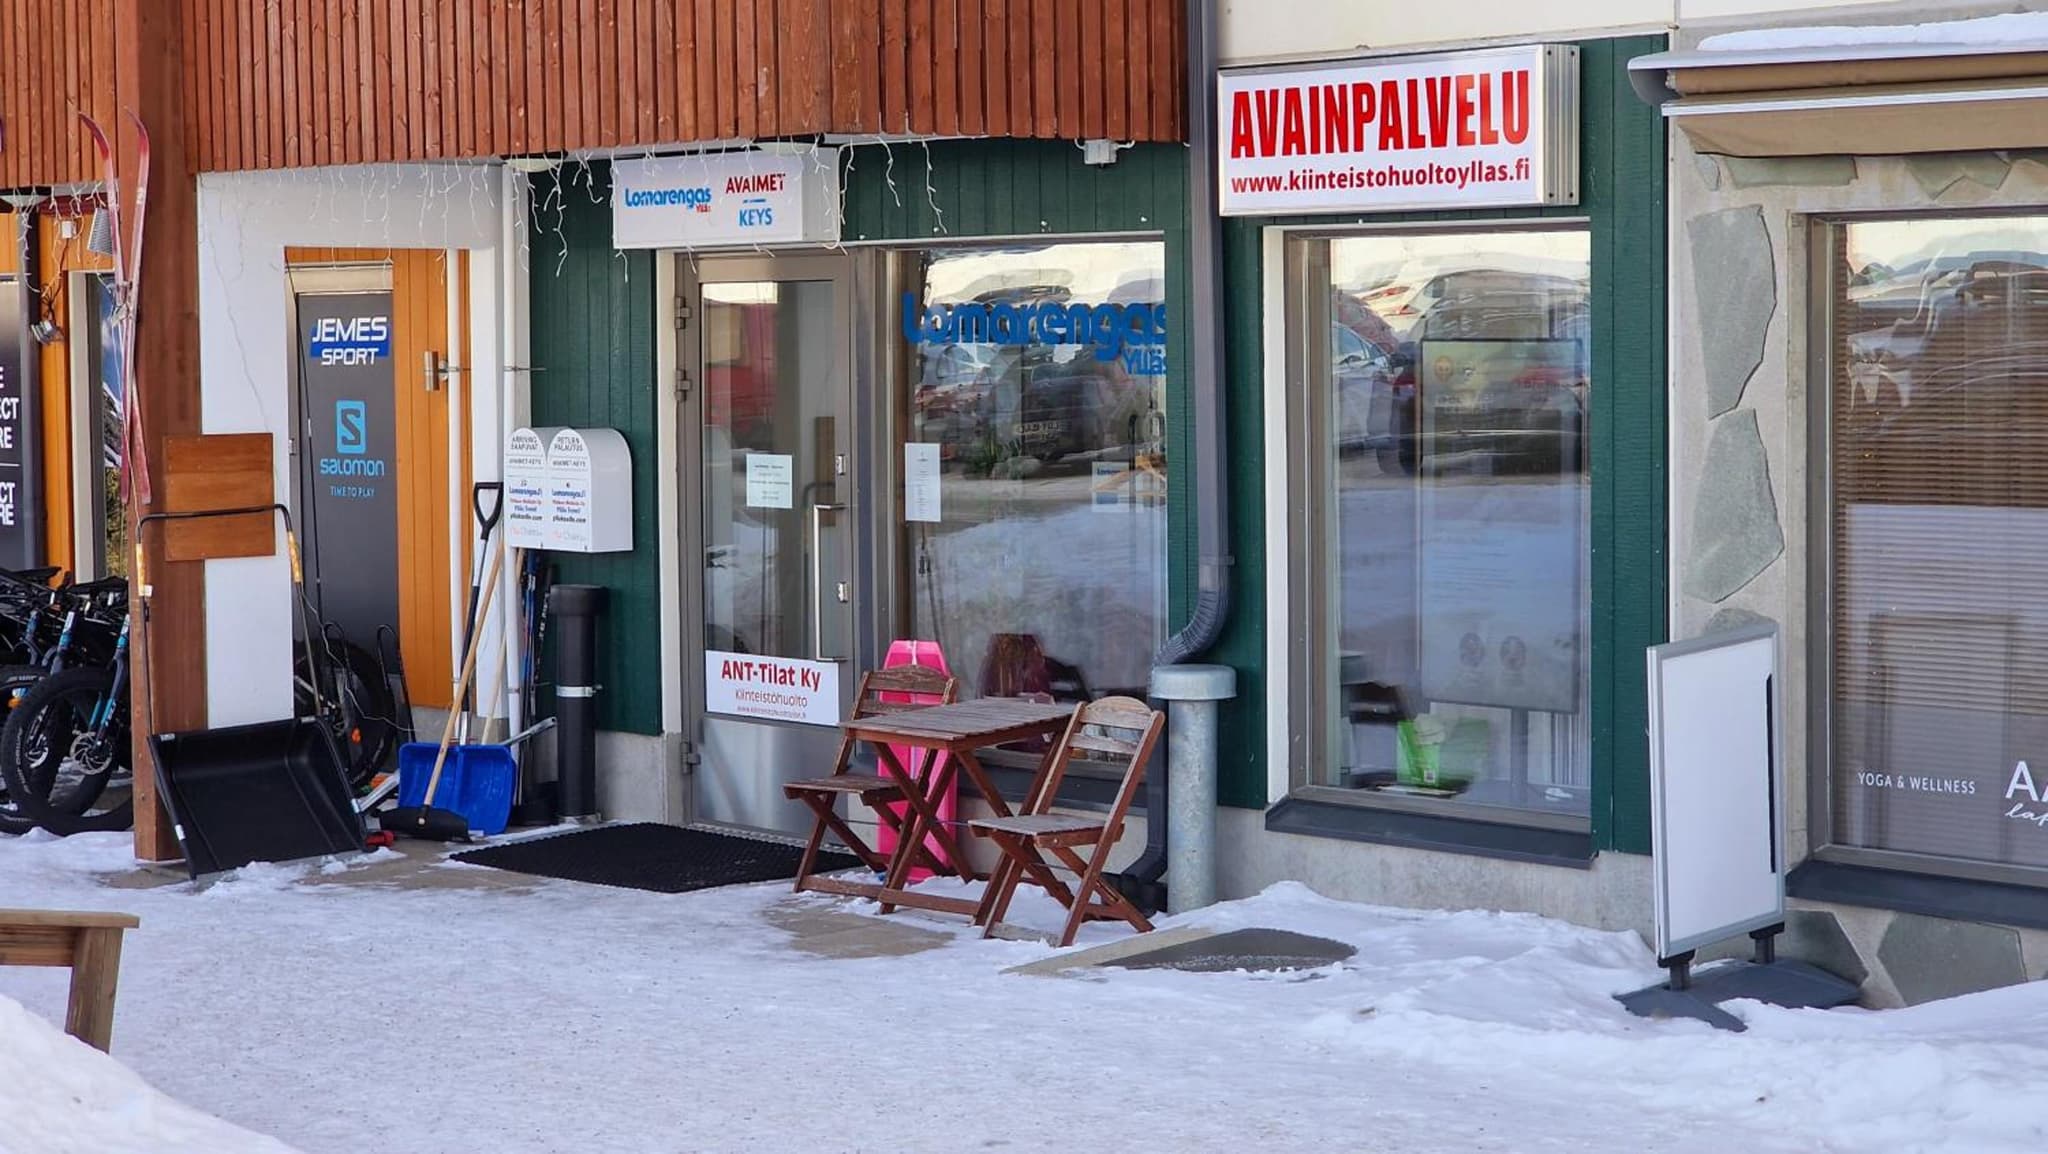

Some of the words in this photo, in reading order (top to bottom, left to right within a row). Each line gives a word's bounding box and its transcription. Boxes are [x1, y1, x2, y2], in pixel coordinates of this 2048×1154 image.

[1230, 69, 1530, 159] AVAINPALVELU
[726, 172, 786, 195] AVAIMET
[1230, 158, 1531, 194] www.kiinteistohuoltoyllas.fi
[625, 186, 712, 208] Lomarengas
[738, 208, 773, 227] KEYS
[312, 316, 388, 343] JEMES
[321, 347, 379, 366] SPORT
[0, 397, 19, 420] CT
[330, 485, 347, 497] TIME
[348, 486, 357, 498] TO
[358, 487, 375, 498] PLAY
[721, 660, 796, 686] ANT-Tilat
[801, 667, 821, 692] Ky
[1857, 771, 1893, 788] YOGA
[1896, 775, 1905, 789] &
[1909, 776, 1976, 794] WELLNESS
[2005, 760, 2048, 802] A
